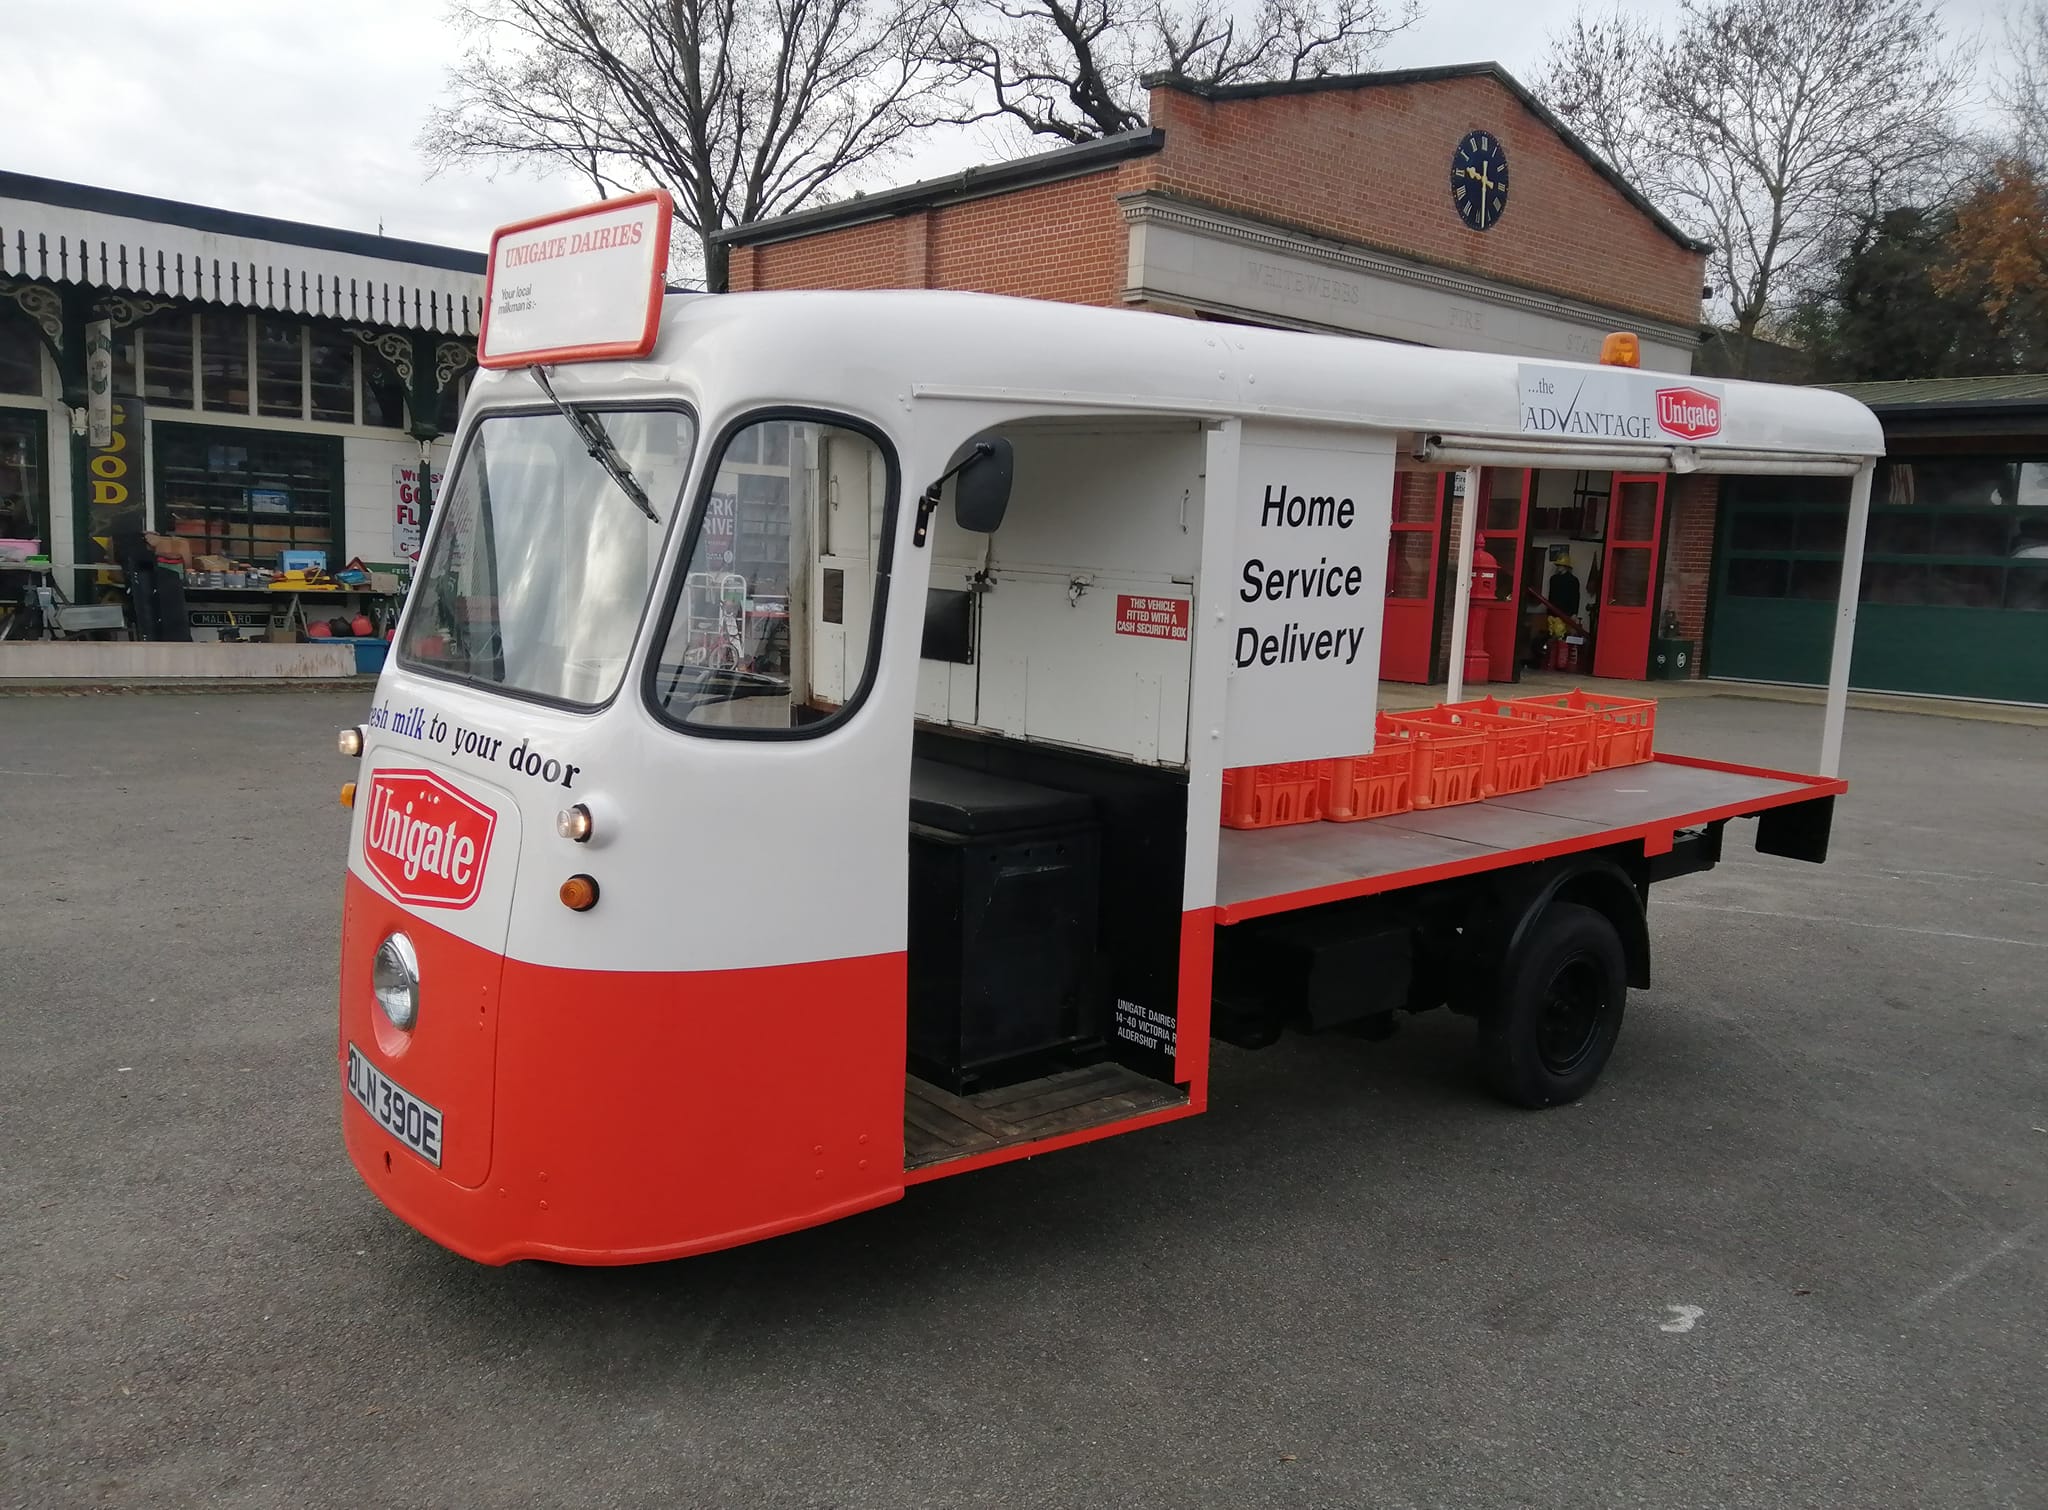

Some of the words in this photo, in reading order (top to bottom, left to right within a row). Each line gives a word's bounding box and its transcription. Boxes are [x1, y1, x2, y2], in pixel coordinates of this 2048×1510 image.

[505, 236, 567, 268] UNIGATE
[569, 221, 643, 255] DAIRIES
[498, 300, 525, 314] milkman
[501, 288, 515, 300] Your
[516, 283, 532, 298] local
[1248, 261, 1360, 305] WHITEWEBBS
[1448, 306, 1483, 331] FIRE
[1522, 374, 1651, 439] ADVANTAGE
[1660, 395, 1718, 431] Unigate
[1261, 485, 1355, 529] Home
[1239, 557, 1362, 603] Service
[202, 615, 252, 624] MALLRD
[1126, 610, 1149, 622] FITTED
[1151, 612, 1169, 624] WITH
[1171, 614, 1177, 625] A
[1130, 598, 1146, 609] THIS
[1147, 600, 1176, 612] VEHICLE
[1117, 621, 1135, 632] CASH
[1136, 624, 1171, 636] SECURITY
[1172, 626, 1186, 638] BOX
[1235, 623, 1365, 668] Delivery
[371, 699, 388, 729] esh
[391, 707, 425, 740] milk
[429, 713, 447, 743] to
[451, 727, 502, 762] your
[509, 738, 580, 788] door
[369, 784, 474, 885] Unigate
[1116, 1012, 1137, 1028] 14-40
[1138, 1020, 1170, 1041] VICTORIA
[1117, 998, 1147, 1019] UNIGATE
[1148, 1010, 1176, 1029] DAIRIES
[1117, 1026, 1158, 1050] ALDERSHOT
[1164, 1044, 1176, 1057] HA
[380, 1084, 438, 1159] 390E
